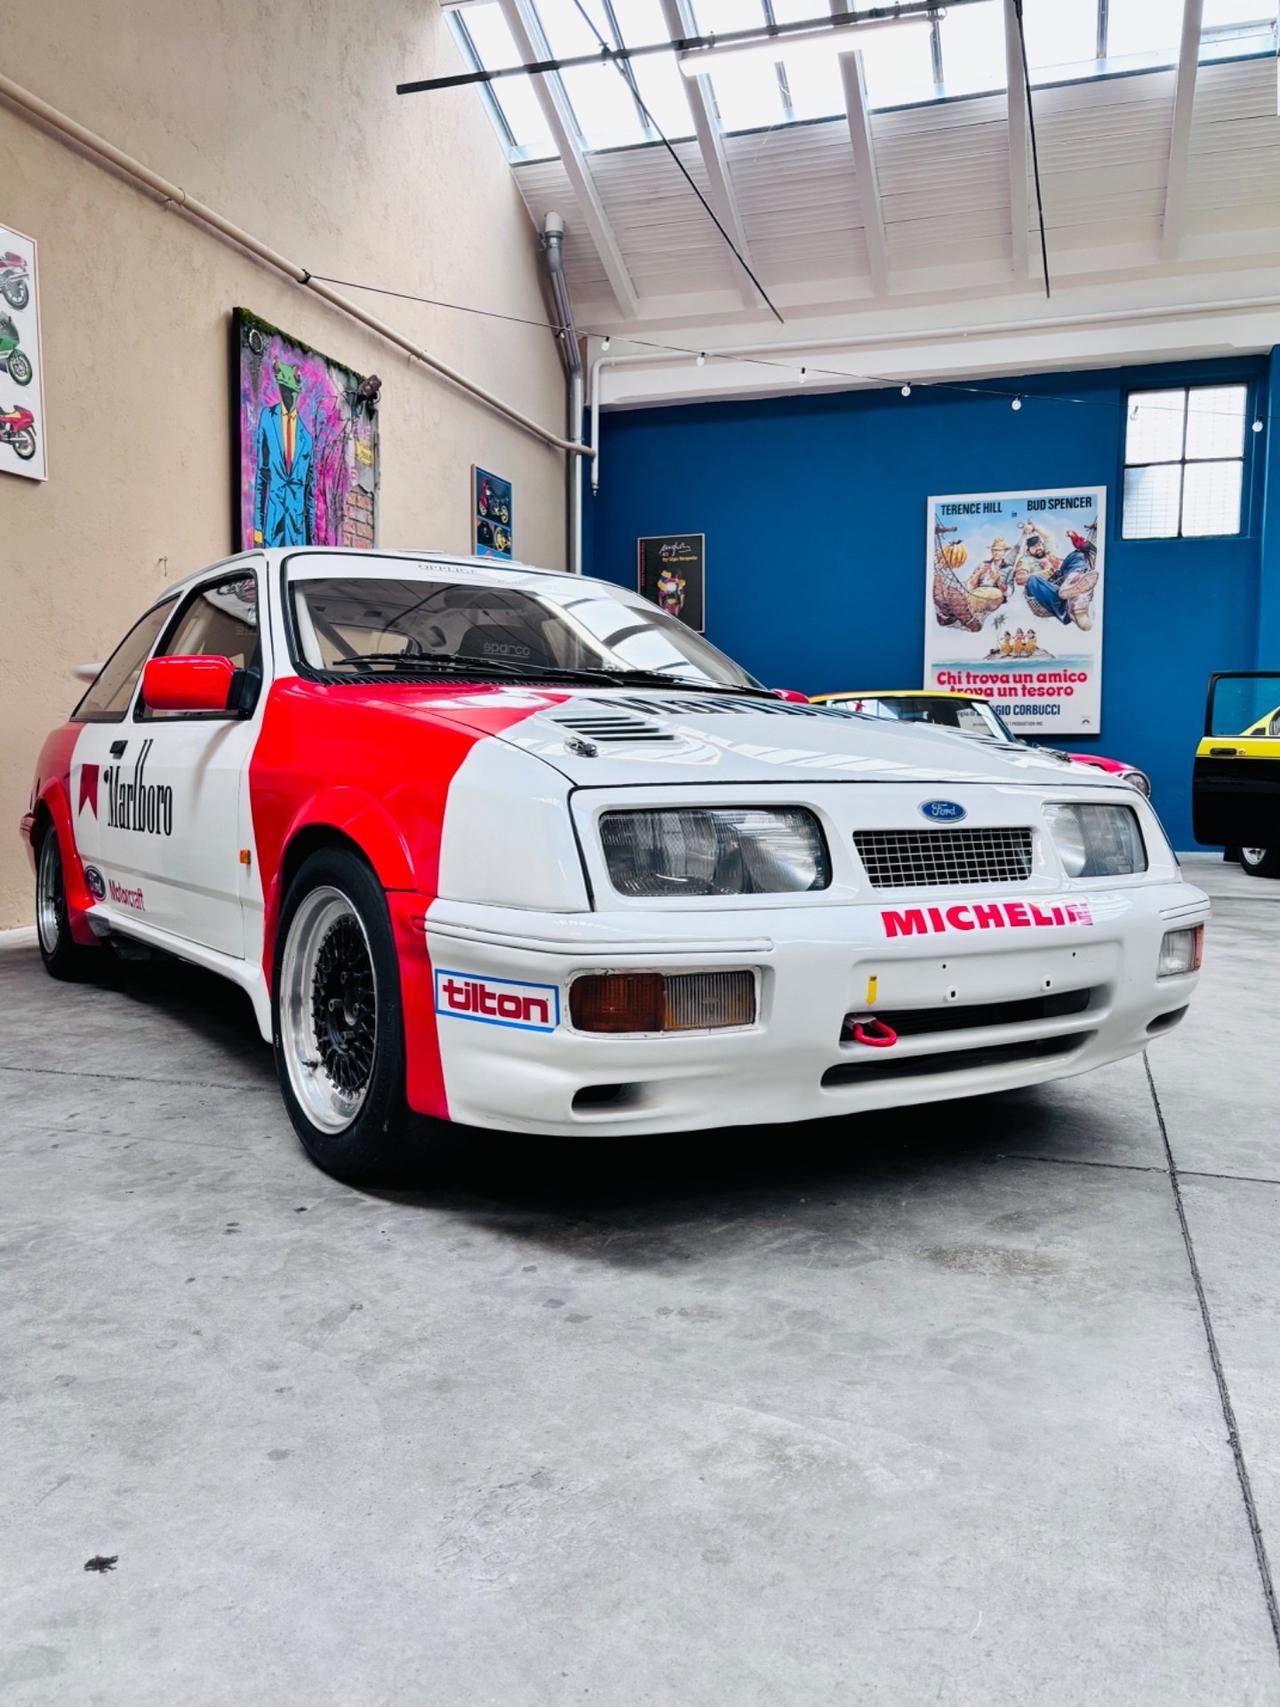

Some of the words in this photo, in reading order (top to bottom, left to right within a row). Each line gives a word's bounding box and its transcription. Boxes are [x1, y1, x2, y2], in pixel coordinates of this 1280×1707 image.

[941, 503, 981, 516] TERENCE
[982, 502, 1003, 513] HILL
[1027, 499, 1046, 511] BUD
[1048, 496, 1092, 510] SPENCER
[483, 642, 530, 655] sparco
[936, 671, 962, 685] Chi
[965, 671, 1010, 685] trova
[1012, 672, 1034, 684] un
[1036, 669, 1088, 684] amico
[997, 685, 1019, 698] un
[1021, 684, 1074, 698] tesoro
[1013, 703, 1061, 716] CORBUCCI
[104, 739, 173, 836] Marlboro
[931, 803, 956, 816] Ford
[108, 879, 146, 912] Motorcraft
[442, 978, 549, 1023] tilton
